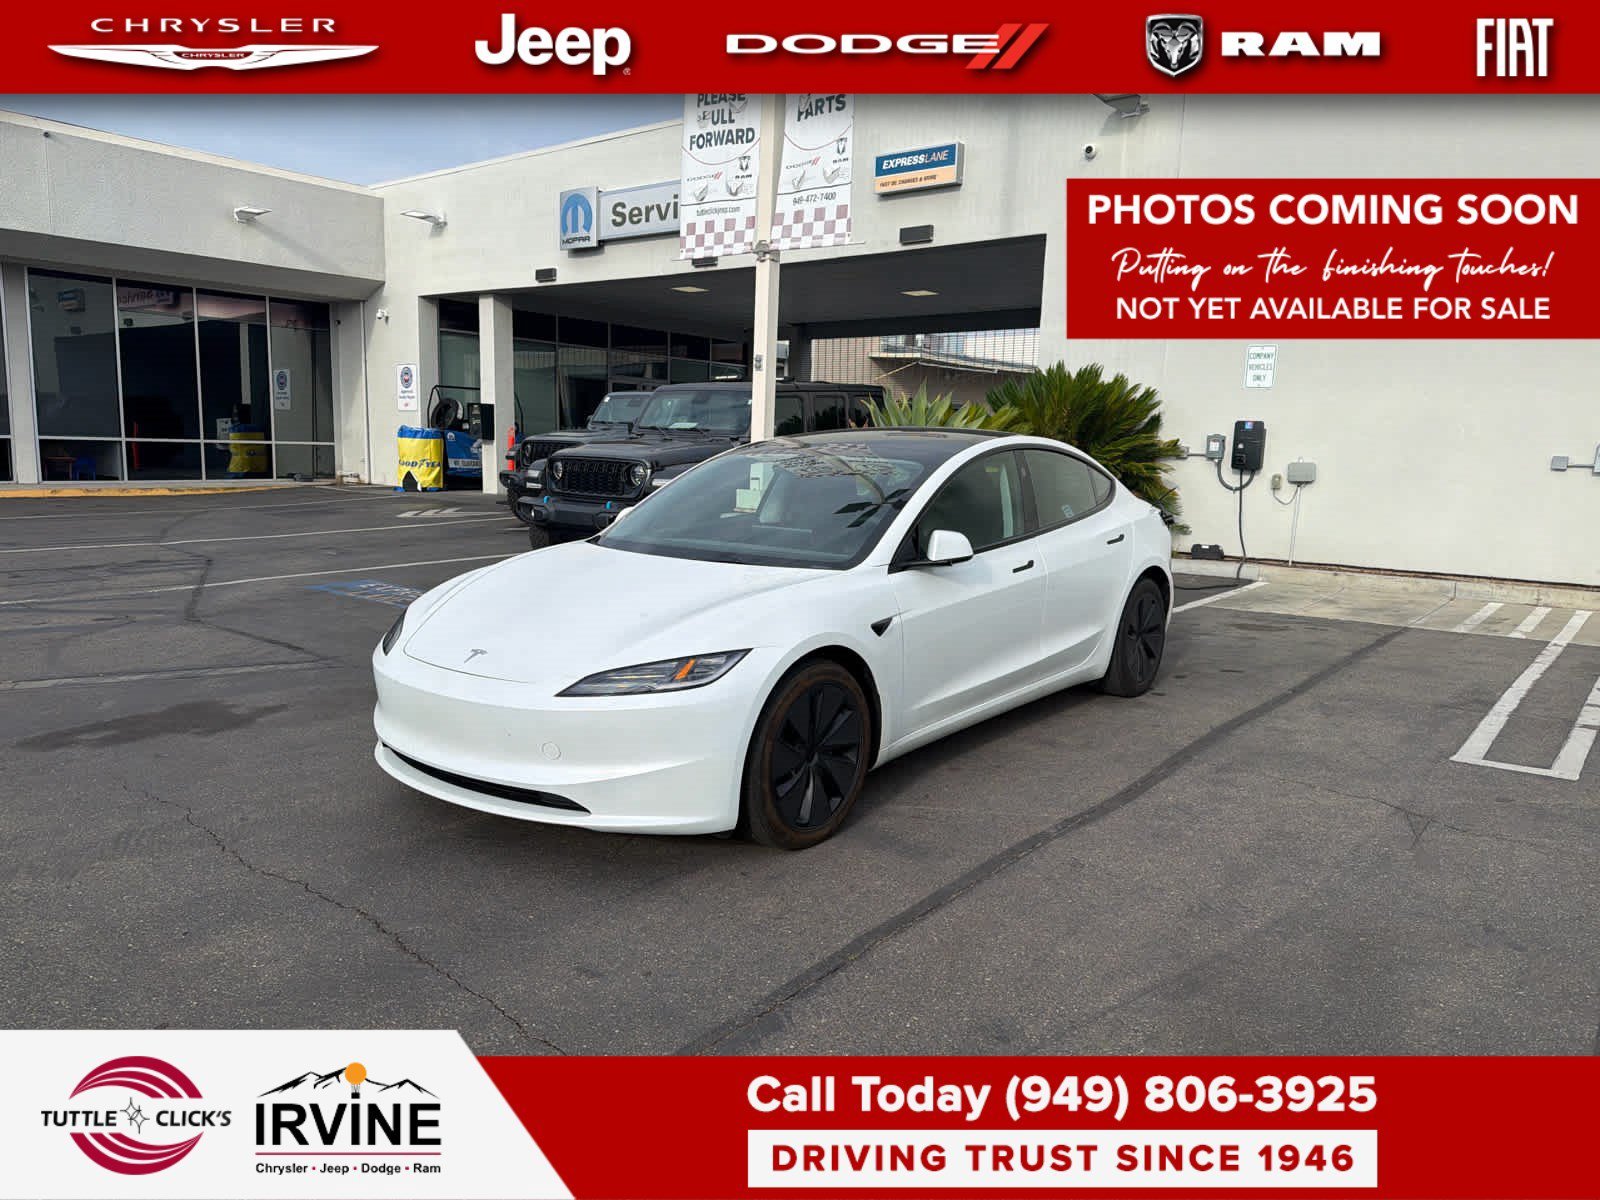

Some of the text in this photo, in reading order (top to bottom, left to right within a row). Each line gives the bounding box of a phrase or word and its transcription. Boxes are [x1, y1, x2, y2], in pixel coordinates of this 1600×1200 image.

[689, 127, 756, 151] FORWARD
[882, 149, 950, 170] EXPRESSLANE
[611, 193, 679, 227] Servi
[562, 235, 591, 245] MOPAR
[1249, 352, 1274, 360] COMPANY
